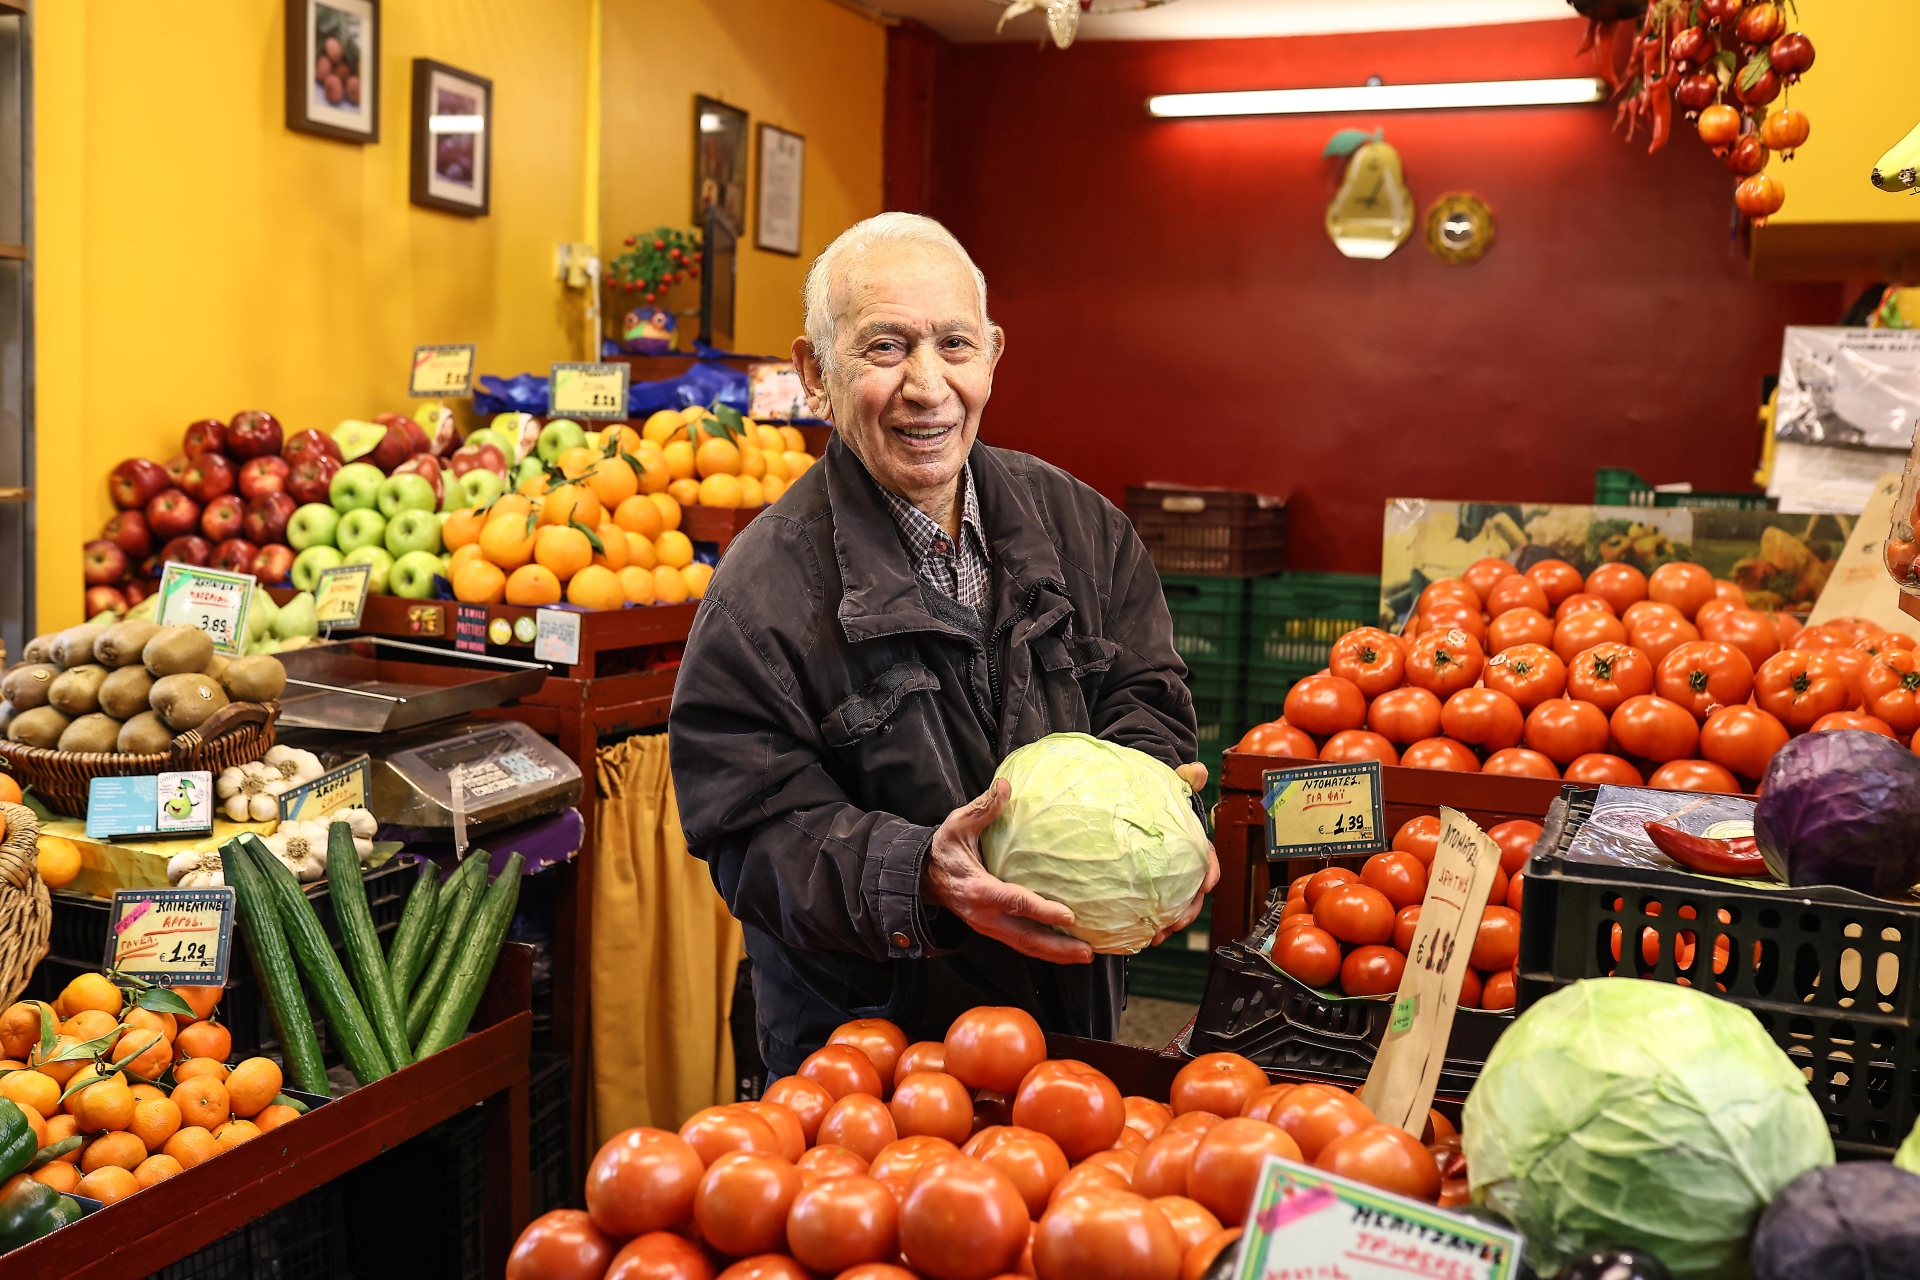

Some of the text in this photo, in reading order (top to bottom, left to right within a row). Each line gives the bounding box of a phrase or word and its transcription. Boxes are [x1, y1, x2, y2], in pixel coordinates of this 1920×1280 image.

[1306, 792, 1322, 805] ΓΙΑ
[1318, 825, 1325, 834] €
[1333, 813, 1364, 835] 1,39
[159, 953, 166, 962] €
[169, 940, 206, 962] 1,29
